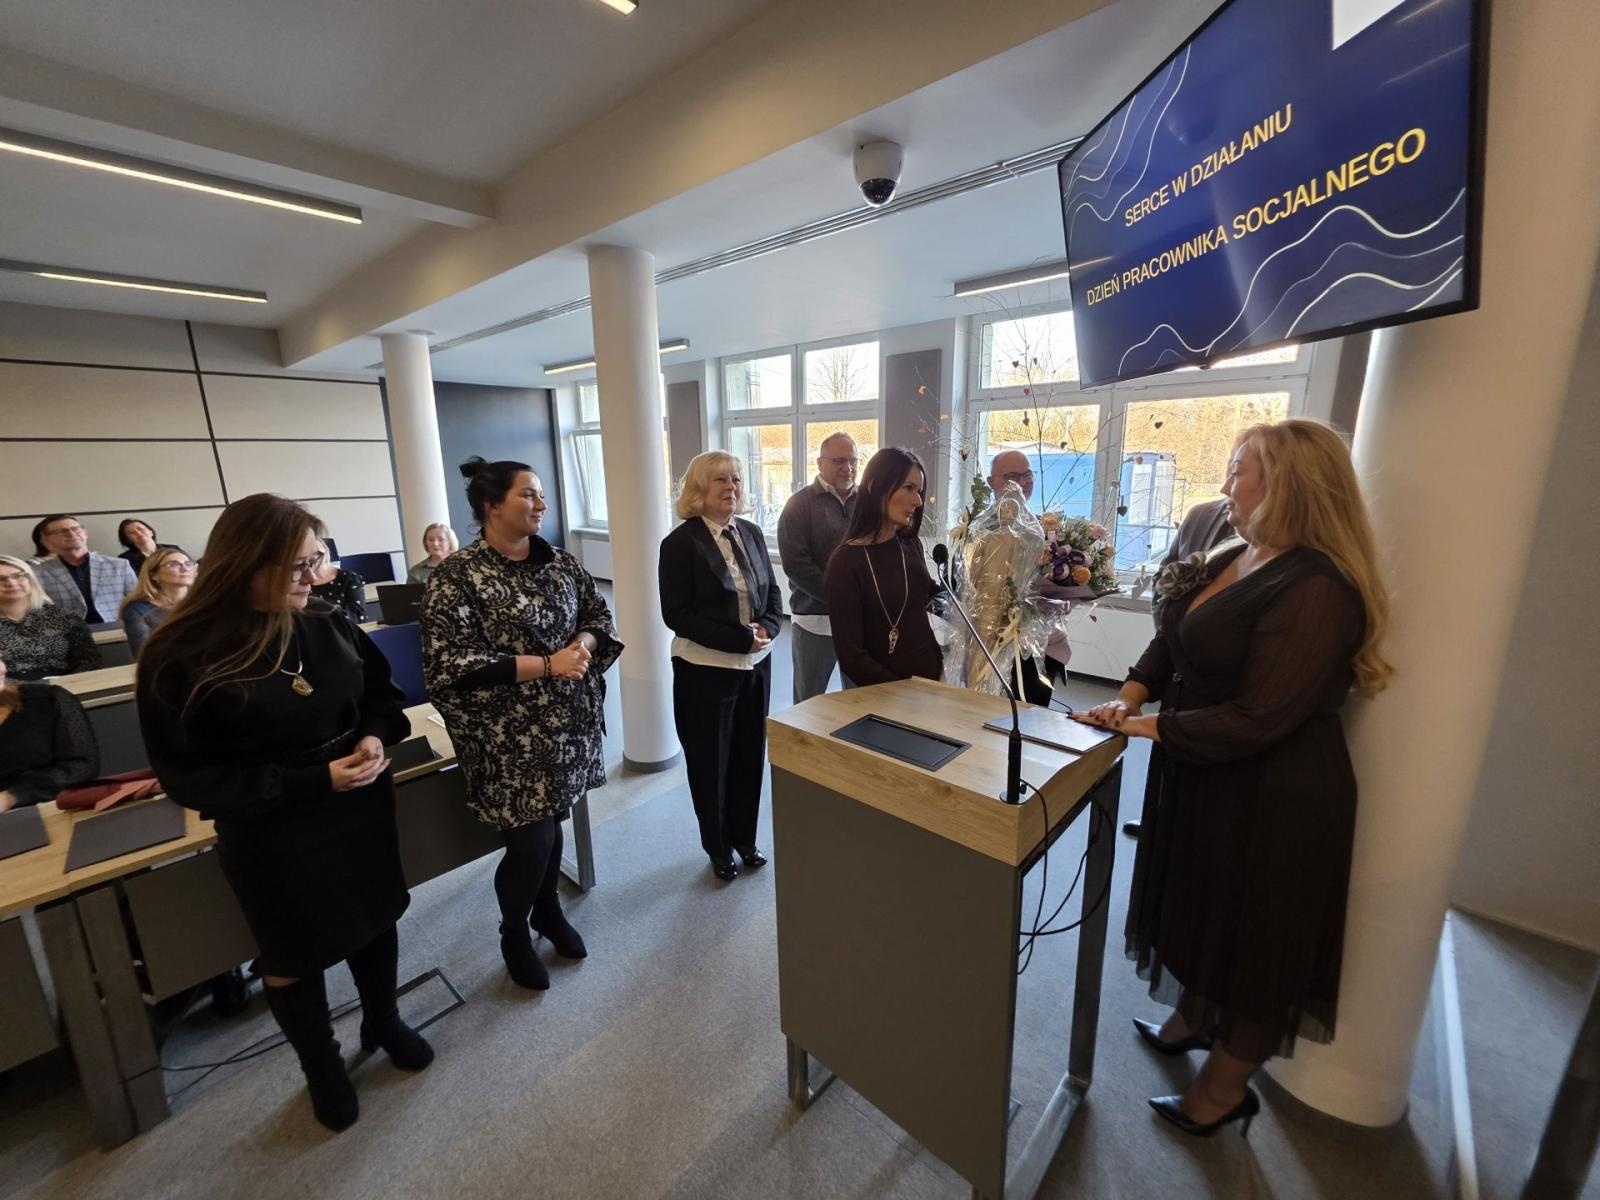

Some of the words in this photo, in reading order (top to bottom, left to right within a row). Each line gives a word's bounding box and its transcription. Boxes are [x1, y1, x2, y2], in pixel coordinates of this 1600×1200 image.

[1087, 273, 1120, 306] DZIEŃ
[1122, 225, 1229, 290] PRACOWNIKA
[1232, 128, 1426, 240] SOCJALNEGO
[1124, 185, 1169, 227] SERCE
[1172, 172, 1189, 197] W
[1190, 103, 1293, 187] DZIAŁANIU
